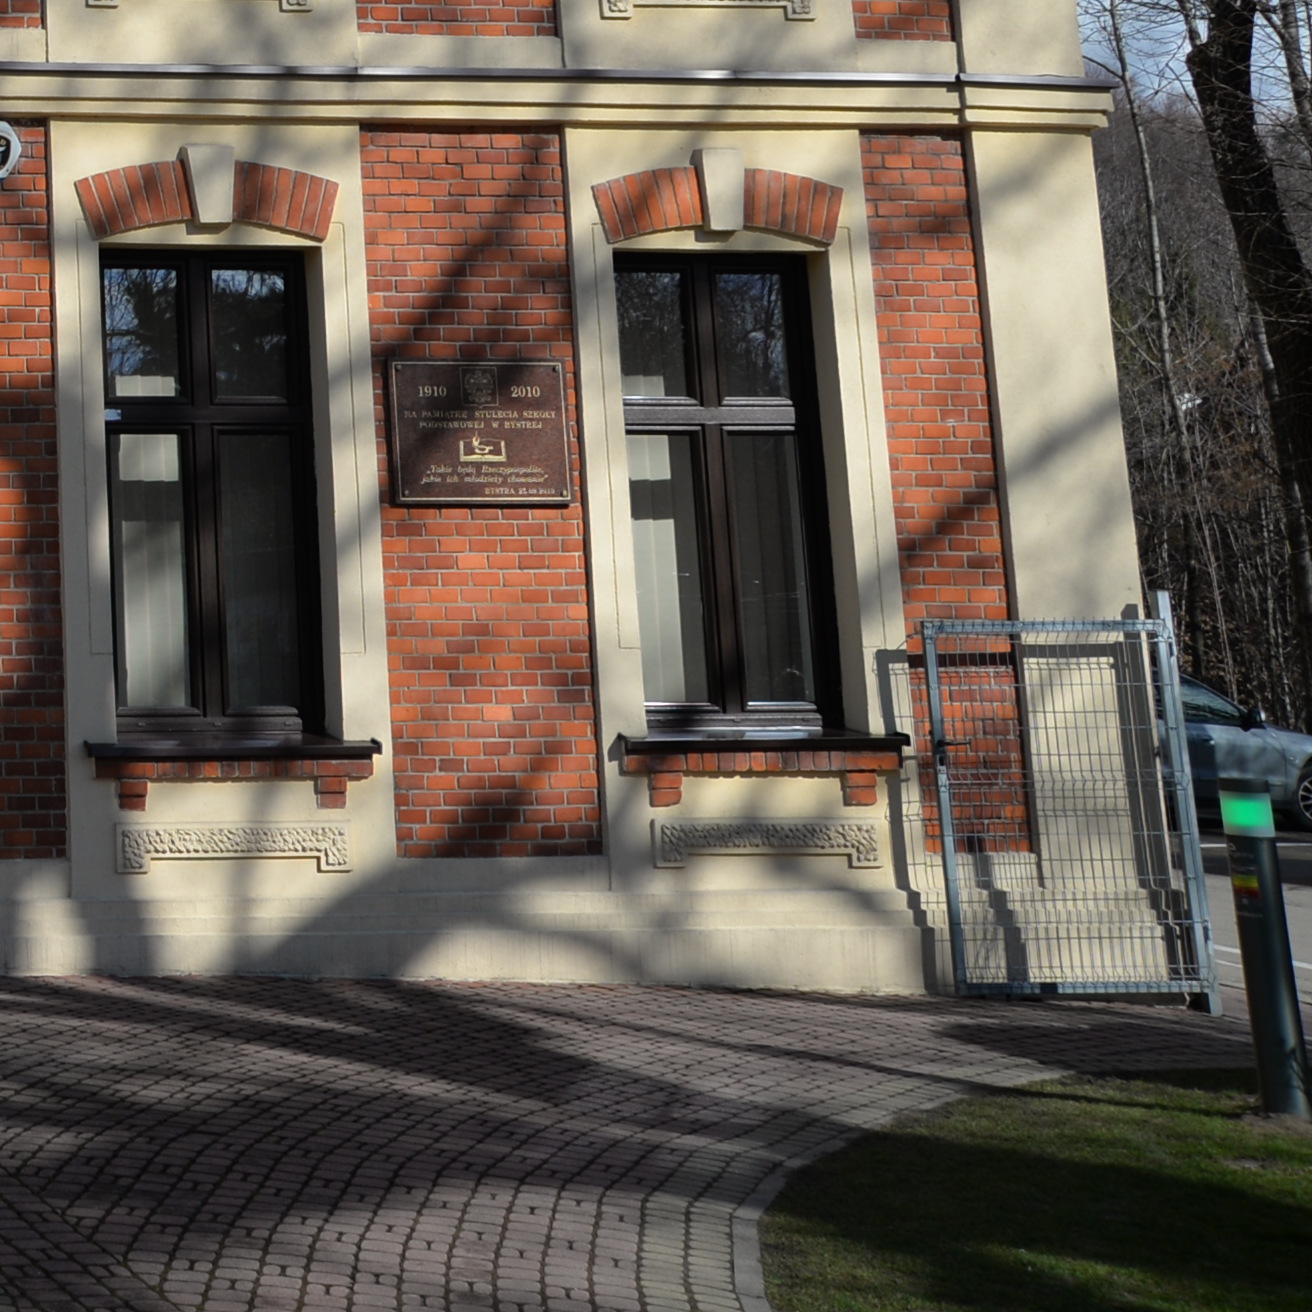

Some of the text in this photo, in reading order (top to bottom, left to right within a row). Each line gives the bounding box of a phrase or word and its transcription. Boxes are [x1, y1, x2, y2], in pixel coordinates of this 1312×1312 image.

[417, 385, 541, 398] 1910 2010
[474, 410, 518, 419] STULECIA
[491, 420, 499, 429] W
[504, 420, 543, 429] BYSTREJ
